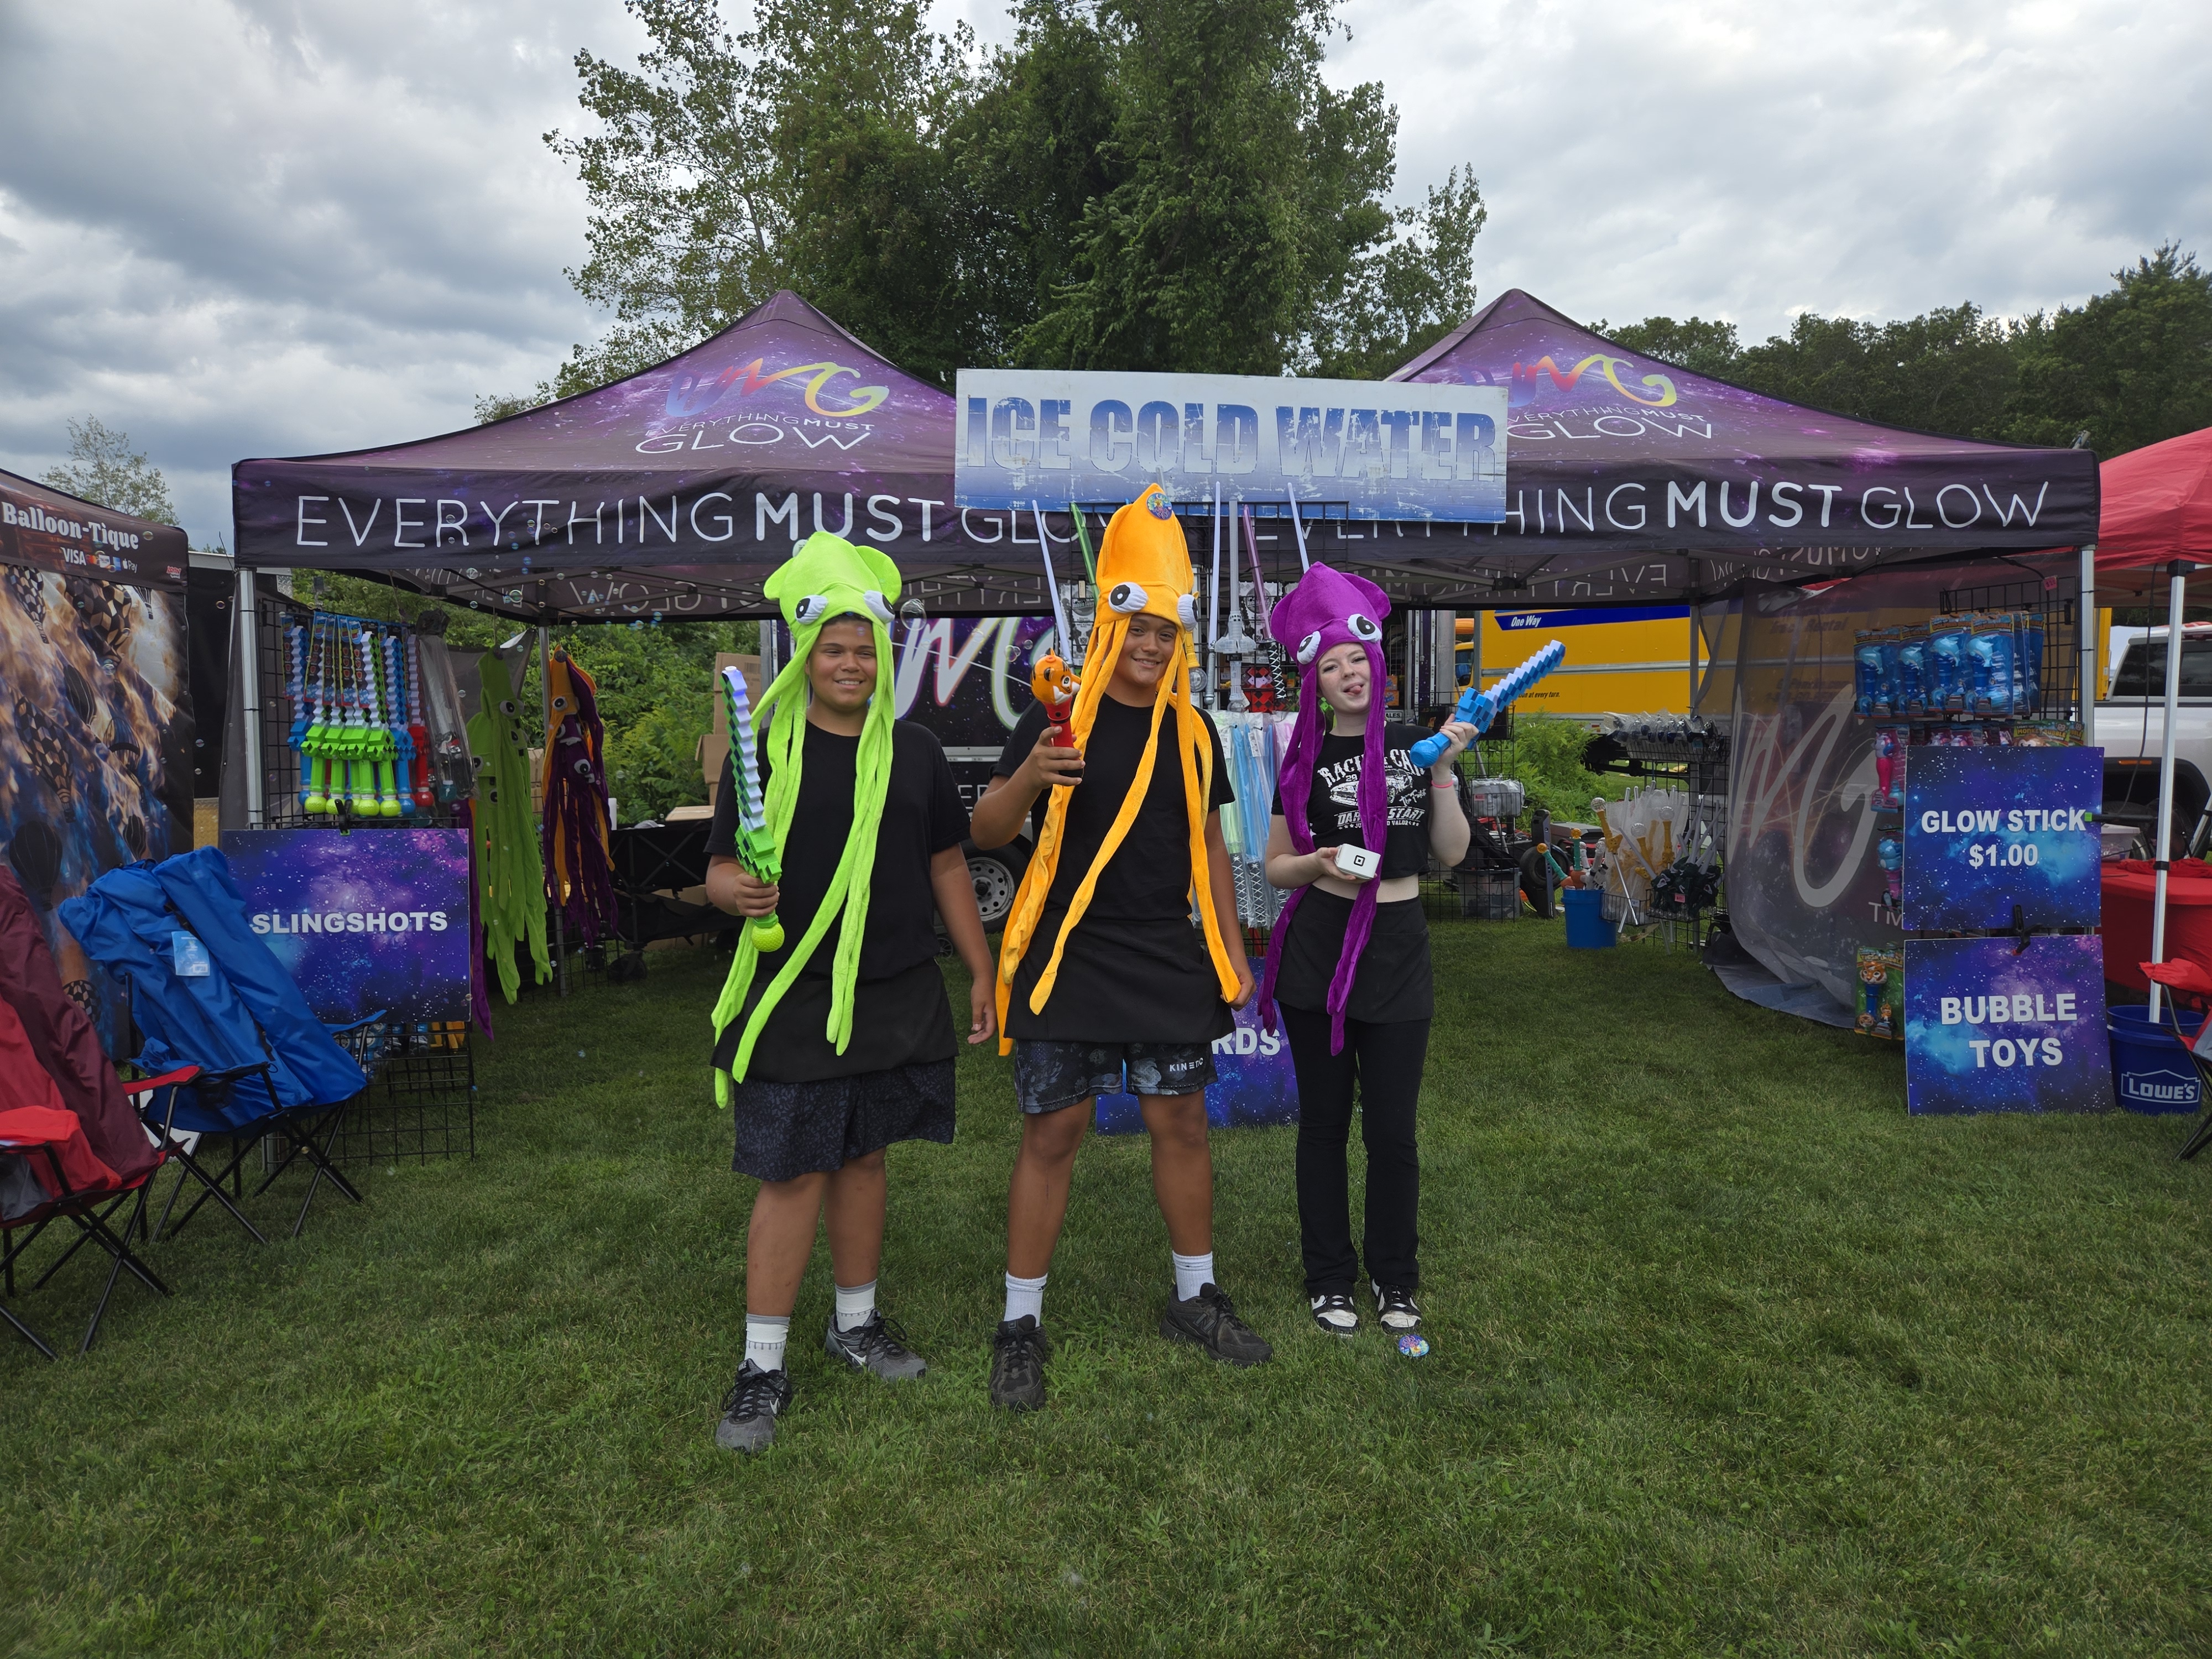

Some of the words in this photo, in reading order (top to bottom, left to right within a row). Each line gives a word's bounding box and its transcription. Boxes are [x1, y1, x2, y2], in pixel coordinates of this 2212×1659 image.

[635, 422, 870, 453] GLOW
[966, 397, 1072, 471] ICE
[1089, 399, 1259, 475] COLD
[1276, 405, 1496, 482] WATER
[1507, 415, 1712, 439] GLOW
[1667, 480, 1843, 528] MUST
[1860, 481, 2049, 529] GLOW
[1, 502, 138, 551] Balloon-Tique
[297, 493, 733, 547] EVERYTHING
[755, 492, 945, 542] MUST
[60, 547, 87, 566] VISA
[128, 560, 138, 573] Pay
[1511, 617, 1524, 627] One
[1525, 615, 1541, 627] Way
[1388, 808, 1425, 820] START
[1922, 810, 2000, 833] GLOW
[2008, 809, 2087, 832] STICK
[1969, 843, 2038, 869] $1.00
[252, 911, 448, 935] SLINGSHOTS
[1940, 993, 2078, 1025] BUBBLE
[1211, 1027, 1280, 1055] RDS
[1969, 1037, 2063, 1067] TOYS
[2129, 1078, 2195, 1099] LOWE'S
